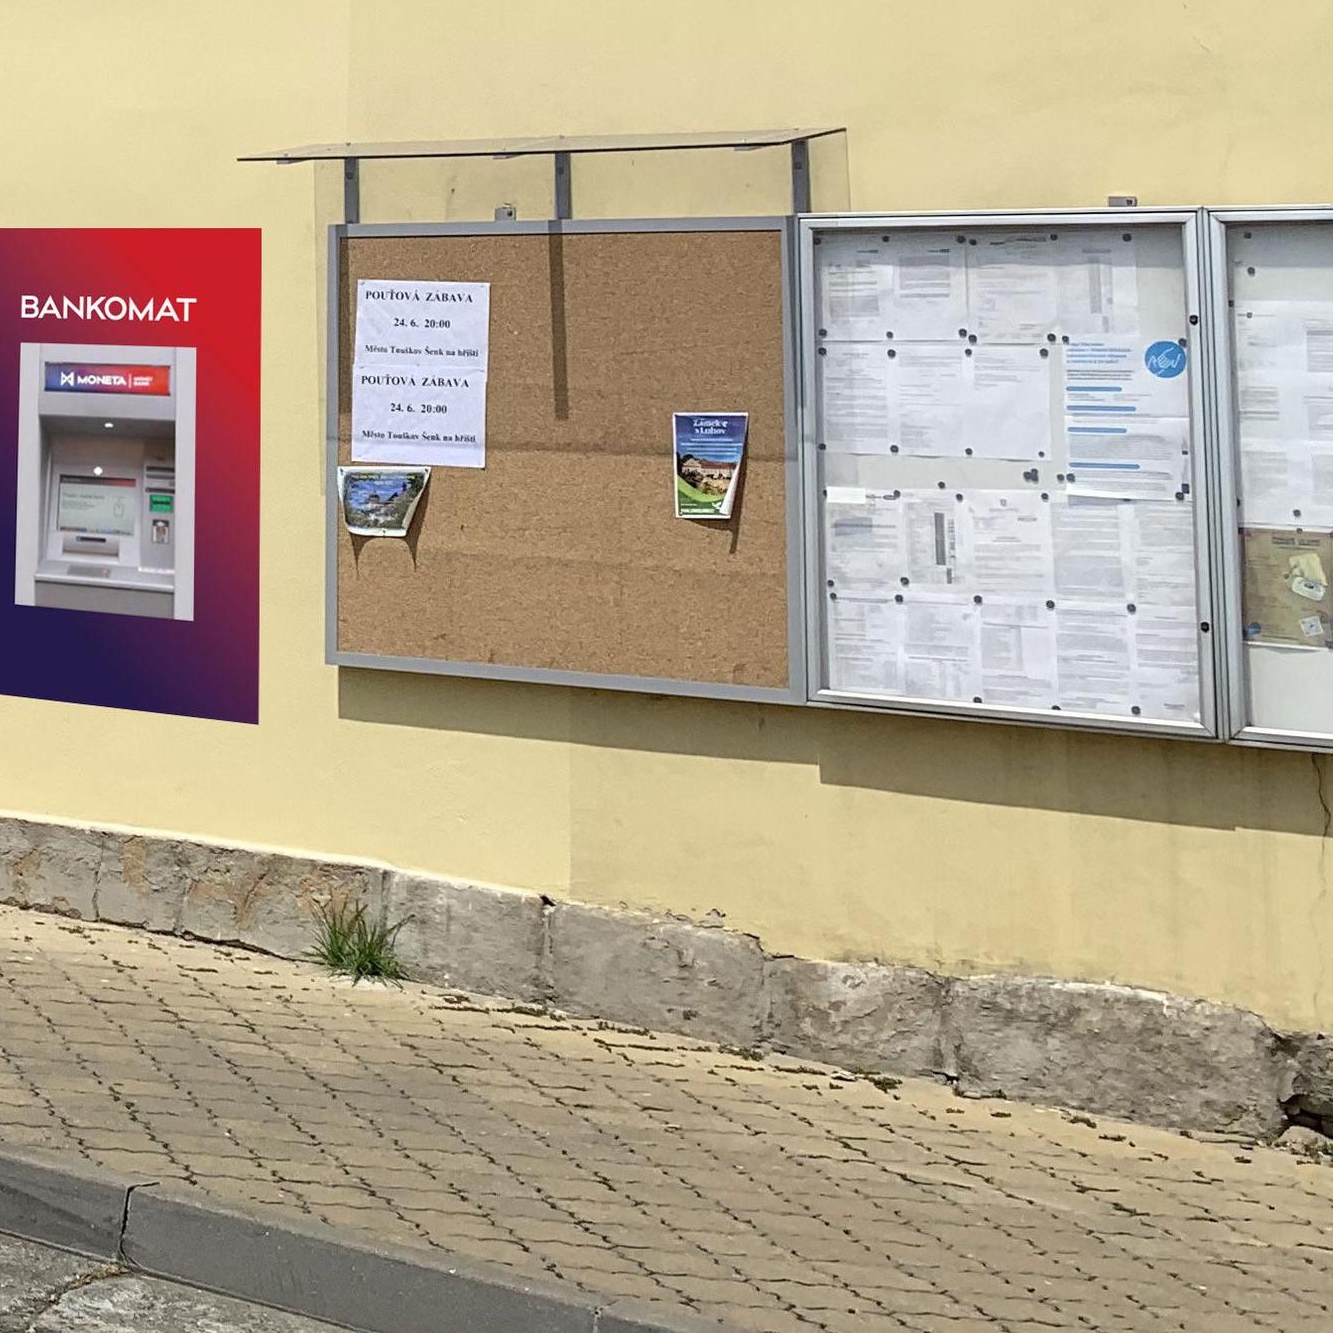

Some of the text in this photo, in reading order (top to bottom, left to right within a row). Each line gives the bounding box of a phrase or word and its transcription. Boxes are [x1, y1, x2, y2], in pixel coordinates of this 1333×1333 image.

[365, 288, 473, 303] POUŤOVÁ ZÁBAVA
[20, 294, 198, 322] BANKOMAT
[394, 317, 451, 329] 24. 6. 20:00
[77, 374, 127, 386] MONETA
[361, 374, 469, 388] POUŤOVÁ ZÁBAVA
[390, 403, 447, 414] 24. 6. 20:00
